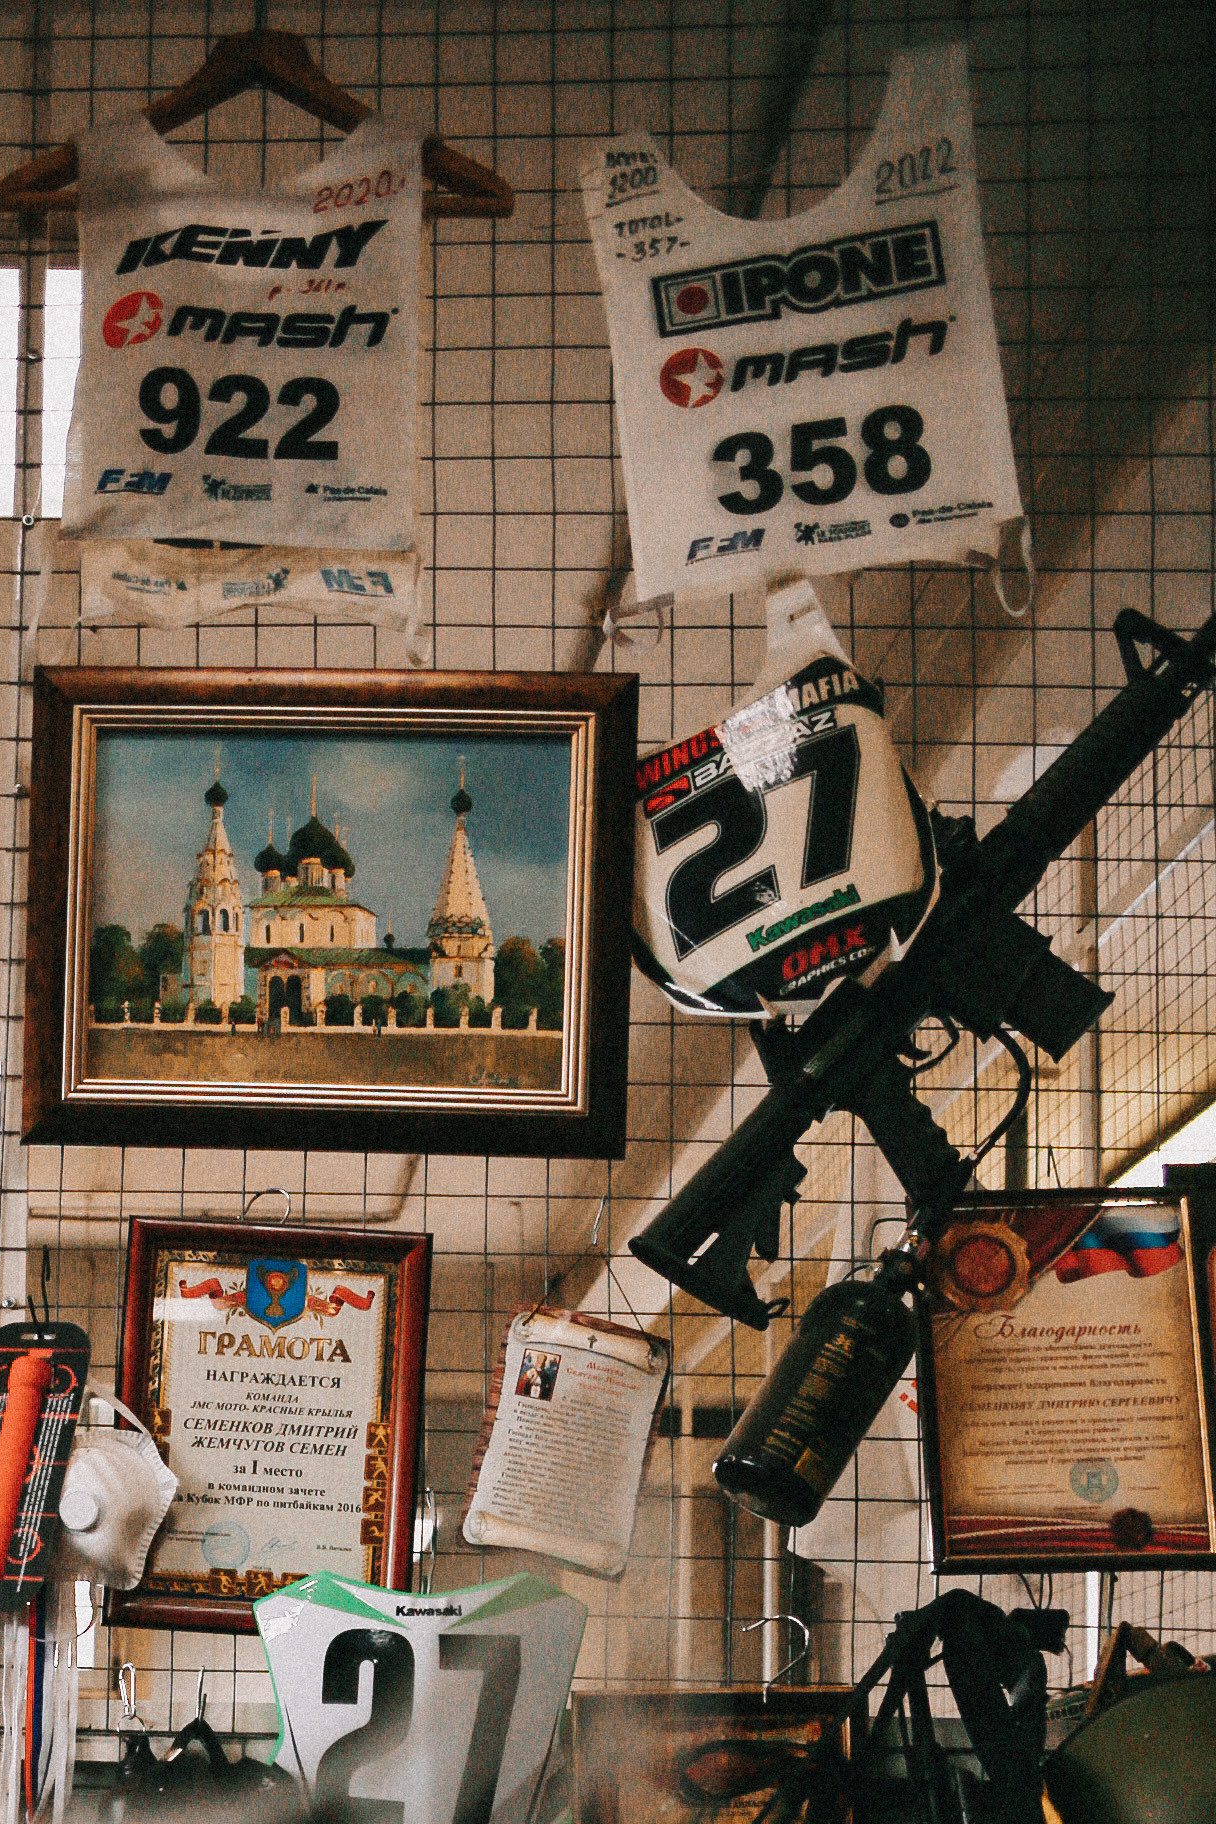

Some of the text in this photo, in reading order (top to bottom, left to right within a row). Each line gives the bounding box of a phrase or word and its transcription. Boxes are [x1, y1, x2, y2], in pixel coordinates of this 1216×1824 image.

[116, 220, 389, 275] KENNY
[721, 230, 936, 313] IPONE
[138, 366, 342, 460] 922
[712, 404, 932, 515] 358
[650, 723, 861, 963] 27
[745, 884, 862, 953] Kawasaki
[974, 1315, 1141, 1344] Благодарность
[197, 1331, 352, 1363] ГРАМОТА
[206, 1369, 342, 1390] НАГРАЖДАЕТСЯ
[245, 1391, 300, 1404] КОМАНДА
[190, 1401, 214, 1411] JMC
[252, 1404, 308, 1417] КРАСНЫЕ
[309, 1407, 353, 1419] КРЫЛЬЯ
[183, 1417, 360, 1441] СЕМЕНКОВ ДМИТРИЙ
[190, 1435, 349, 1457] ЖЕМЧУГОВ СЕМЕН
[232, 1464, 247, 1475] за
[262, 1466, 304, 1479] место
[207, 1482, 327, 1498] в командном зачете
[186, 1492, 222, 1507] Кубок
[224, 1496, 255, 1509] МФР
[256, 1499, 271, 1509] по
[272, 1497, 334, 1513] питбайкам
[336, 1501, 362, 1513] 2016
[395, 1605, 463, 1617] Kawasaki
